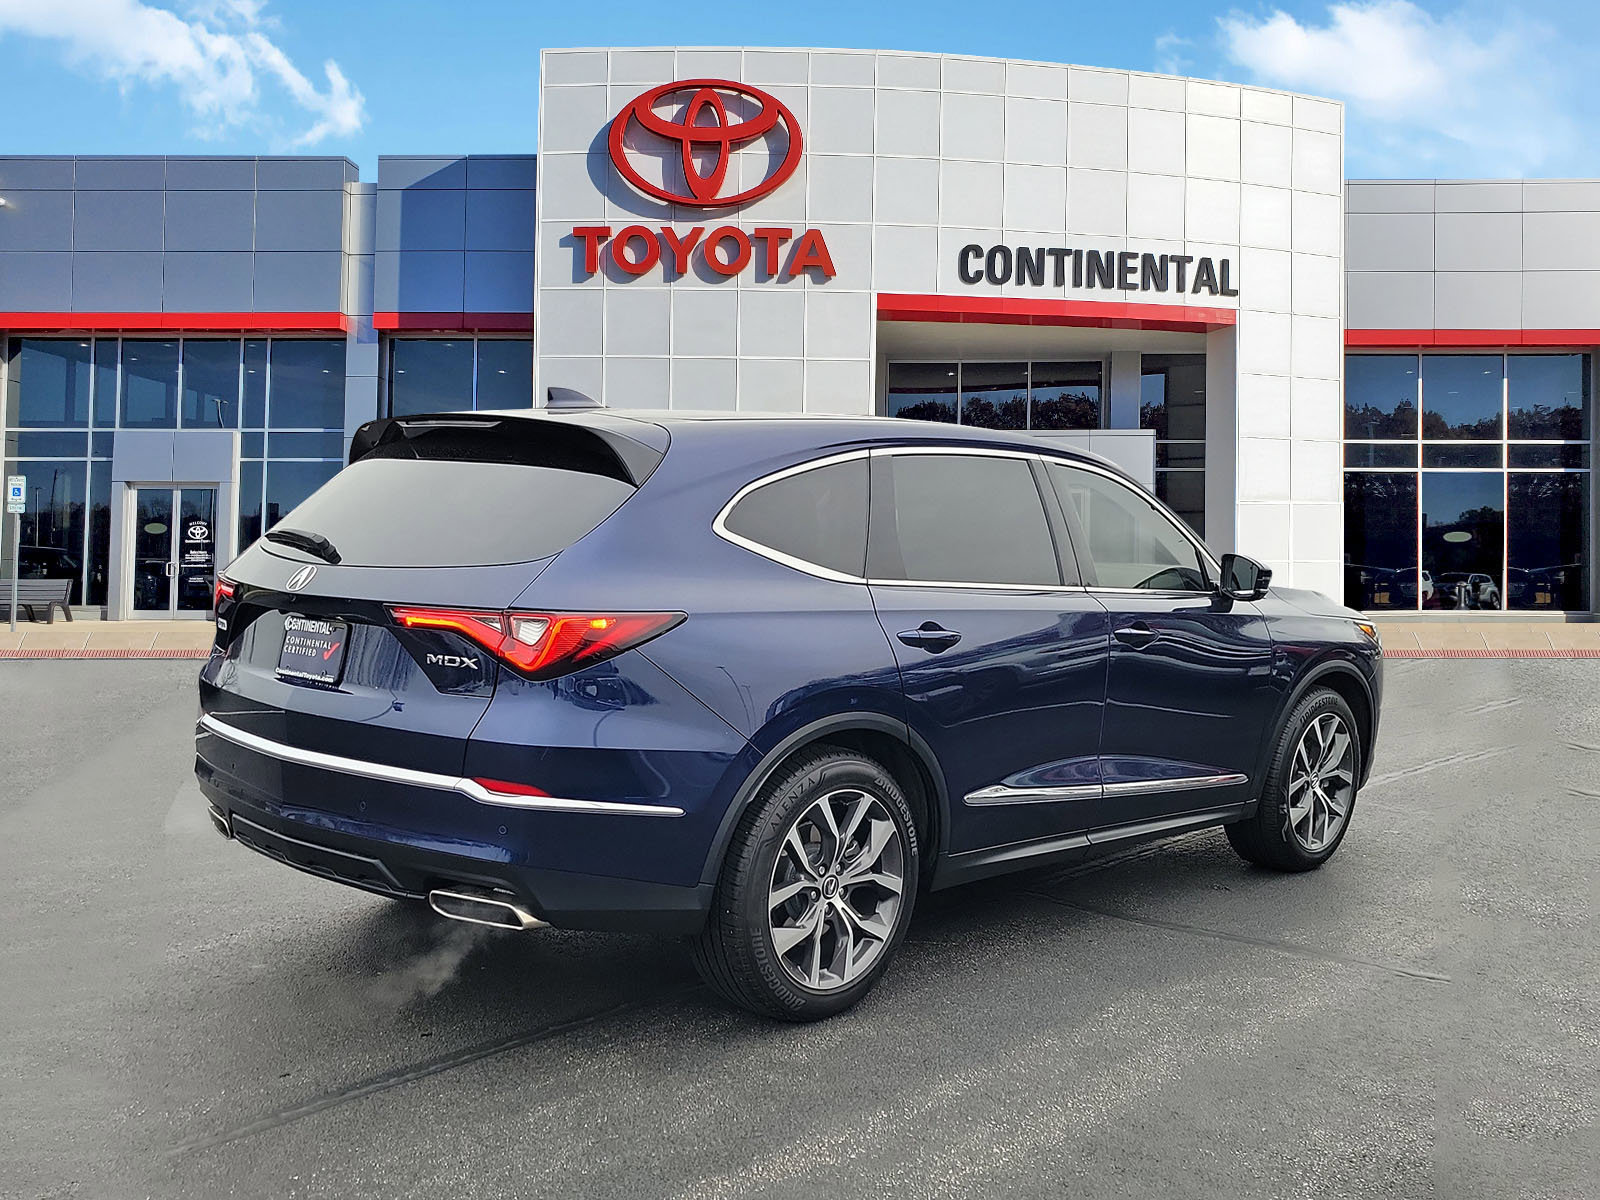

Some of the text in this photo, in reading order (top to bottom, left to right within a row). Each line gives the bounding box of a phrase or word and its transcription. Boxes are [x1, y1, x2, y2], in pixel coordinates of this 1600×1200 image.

[573, 225, 837, 277] TOYOTA
[958, 244, 1239, 297] CONTINENTAL
[283, 645, 317, 657] CERTIFIED
[286, 636, 332, 650] CONTINENTAL
[426, 653, 479, 670] MDX
[275, 667, 334, 683] ContinentalToyota.com
[1300, 696, 1338, 725] BRIDGESTONE
[770, 777, 816, 833] ALENZA
[873, 776, 918, 857] BRIDGESTONE
[749, 927, 807, 1011] BRIDGESTONE
